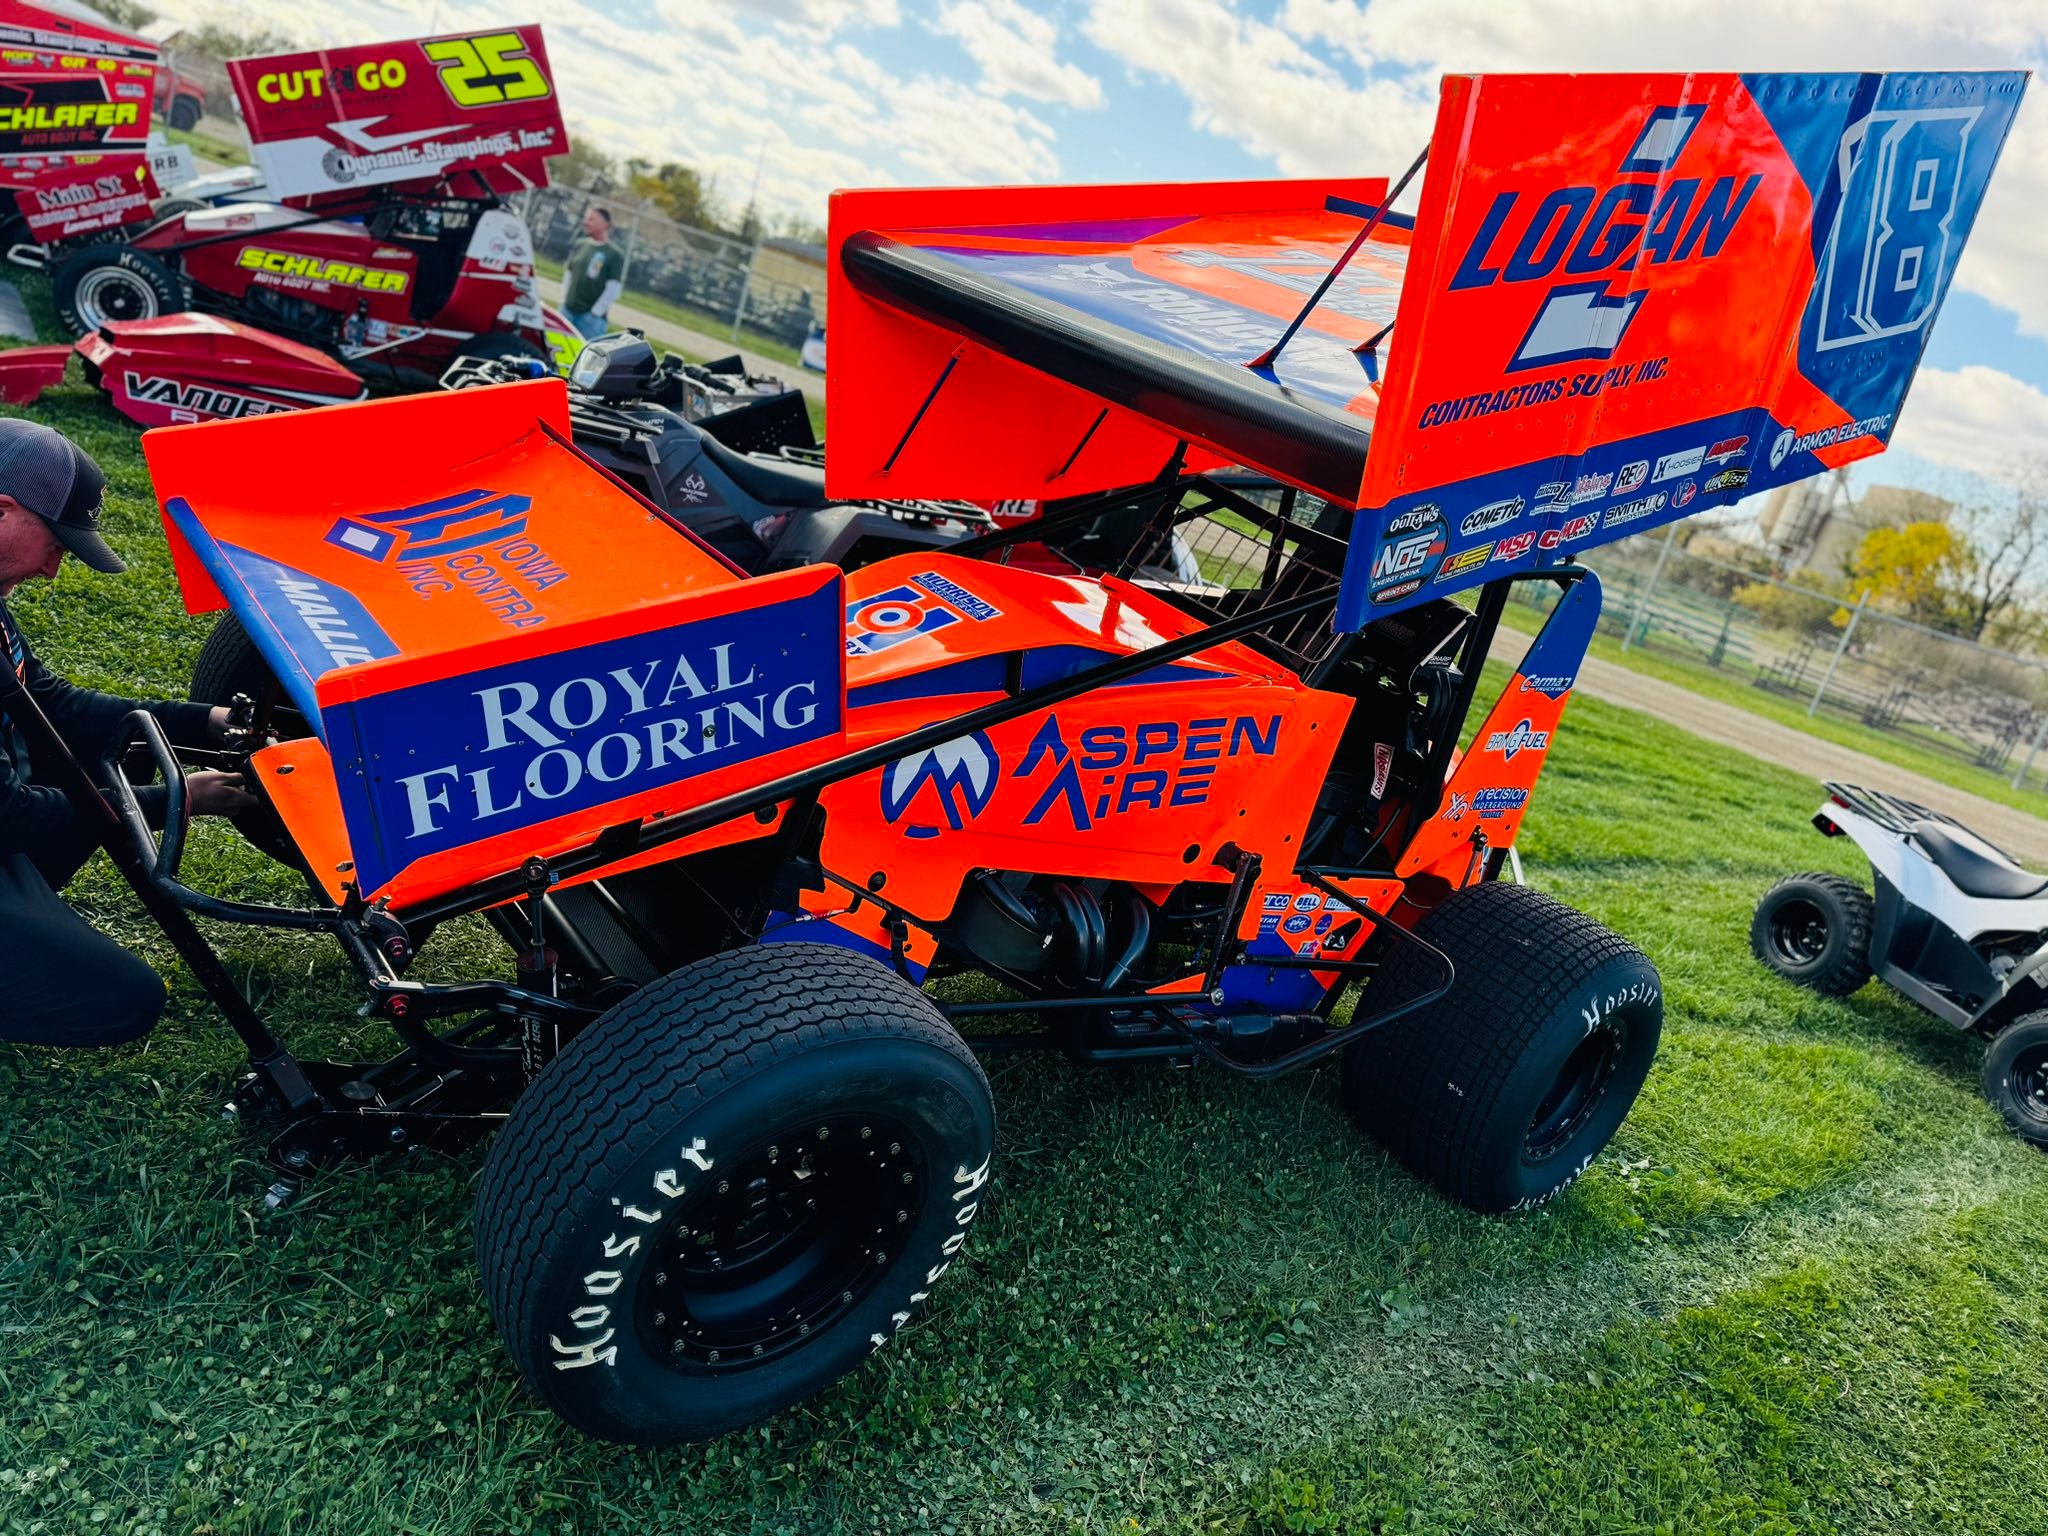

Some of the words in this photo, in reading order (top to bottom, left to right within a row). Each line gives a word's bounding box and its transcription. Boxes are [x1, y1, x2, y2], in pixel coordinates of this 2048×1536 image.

[257, 70, 324, 103] CUT
[356, 60, 407, 92] GO
[423, 33, 550, 107] 25
[342, 144, 420, 177] Dynamic
[421, 136, 520, 163] Stampings,
[1446, 172, 1764, 292] LOGAN
[239, 248, 408, 293] SCHLAFER
[1418, 378, 1568, 430] CONTRACTORS
[1633, 356, 1670, 384] INC.
[1789, 427, 1838, 455] ARMOR
[1836, 413, 1892, 442] ELECTRIC
[1461, 497, 1525, 531] COMETIC
[490, 536, 570, 592] IOWA
[1374, 528, 1439, 579] NOS
[1493, 532, 1537, 557] MSD
[445, 554, 548, 629] CONTRA
[919, 572, 1001, 618] MORRISON
[471, 641, 755, 754] ROYAL
[395, 680, 820, 840] FLOORING
[1517, 732, 1547, 748] FUEL
[1474, 788, 1530, 806] precision
[1296, 897, 1317, 907] BELL
[549, 1136, 714, 1371] Hoosier
